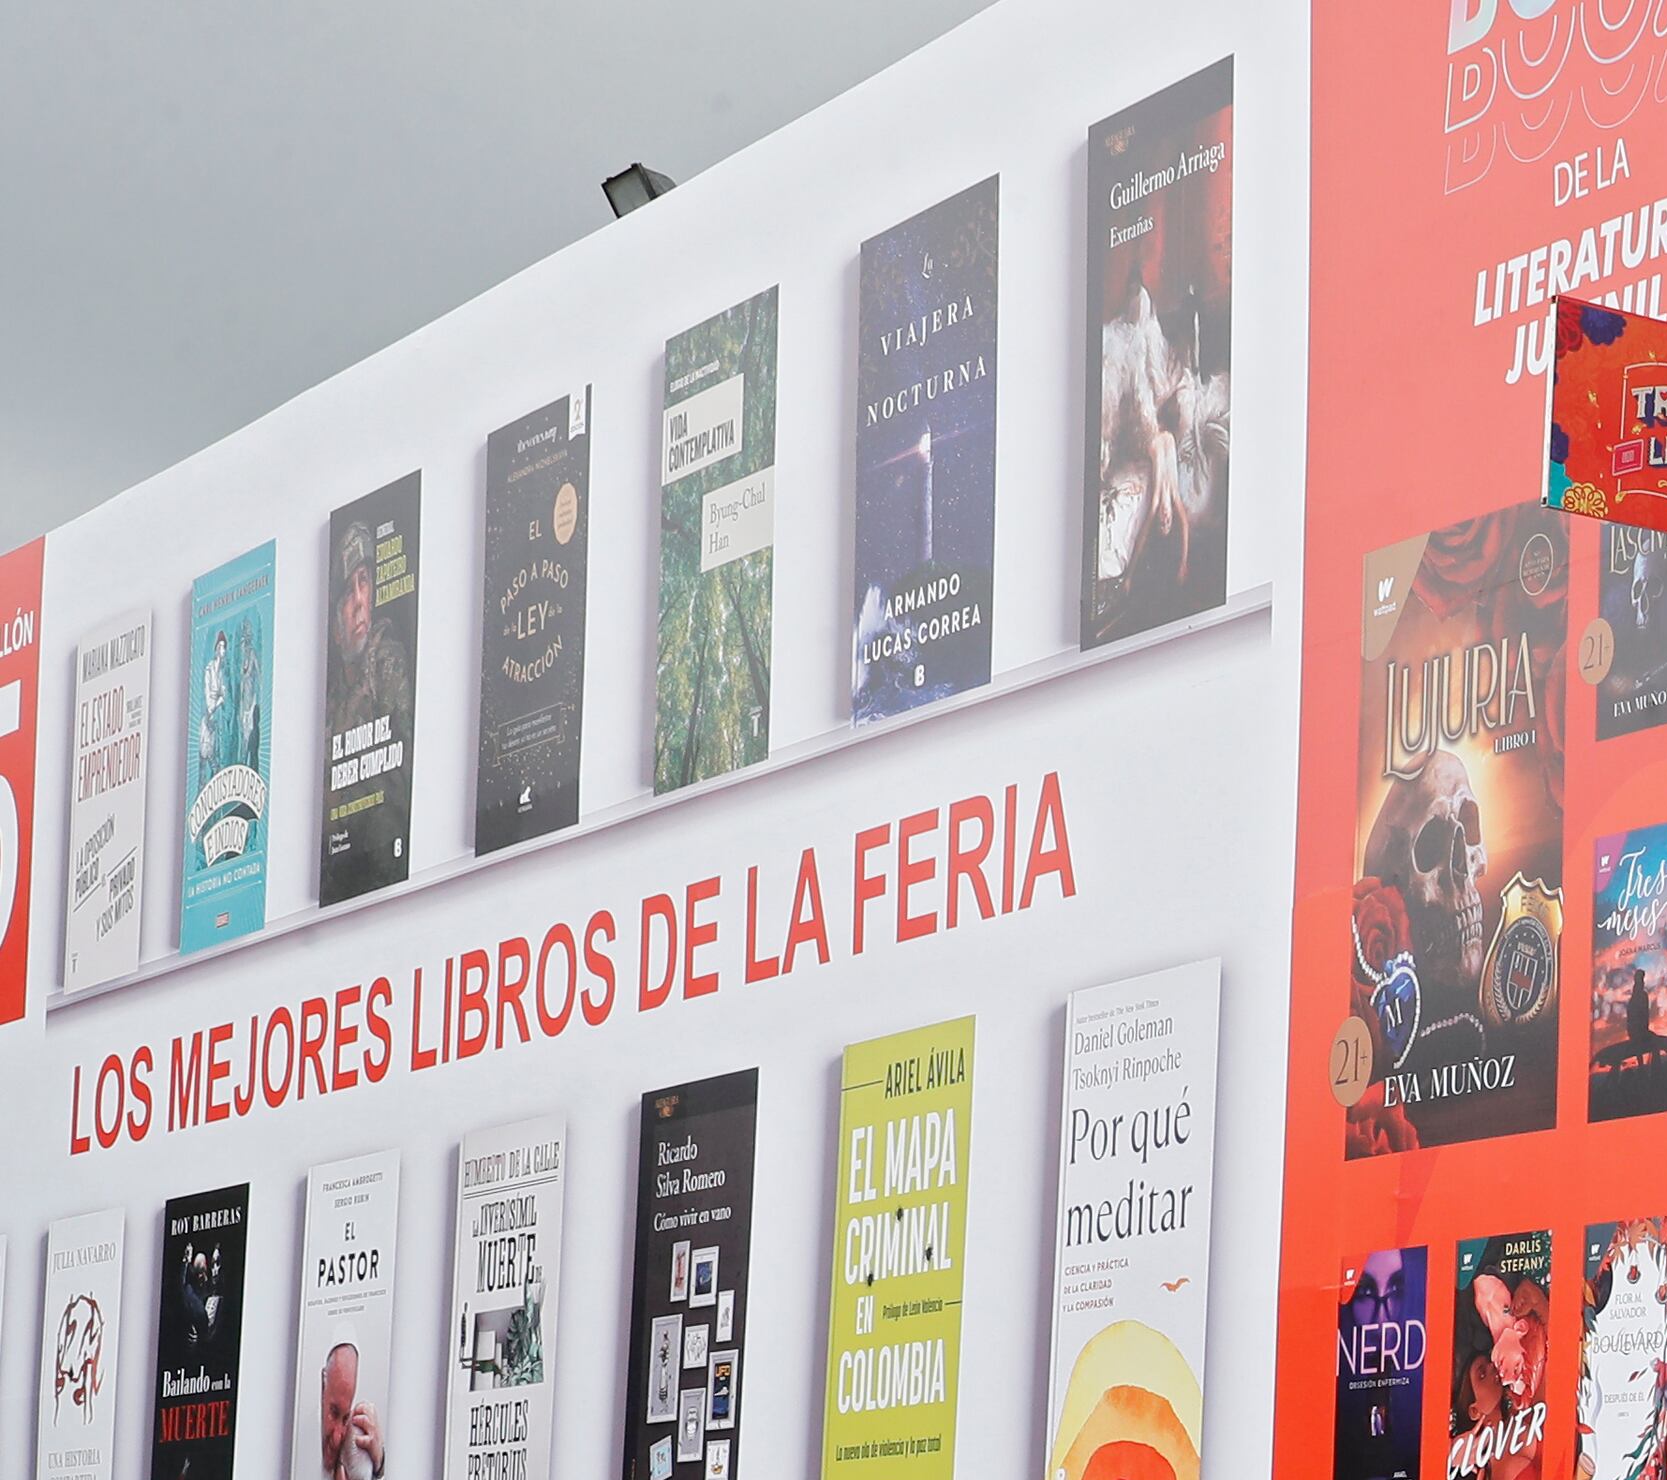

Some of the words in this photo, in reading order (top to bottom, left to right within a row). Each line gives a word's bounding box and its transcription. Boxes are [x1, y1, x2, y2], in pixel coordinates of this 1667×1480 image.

[1110, 166, 1174, 210] Guillermo
[1177, 141, 1225, 179] Arriaga
[1553, 153, 1588, 207] DE
[1596, 138, 1630, 190] LA
[1110, 216, 1154, 248] Extrañas
[880, 296, 973, 356] VIAJERA
[866, 355, 987, 427] NOCTURNA
[669, 419, 734, 472] CONTEMPLATIVA
[670, 412, 687, 442] VIDA
[710, 483, 765, 528] Byung-Chul
[709, 534, 728, 553] Han
[516, 600, 549, 640] LEY
[883, 573, 961, 621] ARMANDO
[863, 626, 912, 665] LUCAS
[917, 604, 981, 645] CORREA
[502, 635, 564, 682] ATRACCIÓN
[1382, 632, 1536, 781] LUJURIA
[190, 771, 265, 837] CONQUISTADORES
[70, 1044, 153, 1156] LOS
[166, 976, 391, 1132] MEJORES
[411, 909, 615, 1071] LIBROS
[639, 876, 720, 1012] DE
[744, 847, 829, 983] LA
[853, 773, 1076, 955] FERIA
[1074, 1023, 1113, 1056] Daniel
[1117, 1014, 1173, 1047] Goleman
[883, 1059, 922, 1099] ARIEL
[927, 1047, 965, 1089] ÁVILA
[1072, 1058, 1118, 1092] Tsoknyi
[1122, 1050, 1181, 1085] Rinpoche
[1335, 1038, 1369, 1084] 21+
[1383, 1068, 1423, 1110] EVA
[1430, 1054, 1516, 1097] MUÑOZ
[1069, 1107, 1124, 1166] Por
[1130, 1085, 1192, 1168] qué
[657, 1136, 698, 1166] Ricardo
[848, 1126, 876, 1204] EL
[883, 1108, 956, 1198] MAPA
[656, 1172, 680, 1198] Silva
[683, 1169, 726, 1192] Romero
[171, 1213, 189, 1235] ROY
[192, 1207, 241, 1233] BARRERAS
[344, 1221, 355, 1242] EL
[1065, 1180, 1193, 1248] meditar
[845, 1201, 951, 1285] CRIMINAL
[1500, 1255, 1545, 1273] STEFANY
[1505, 1239, 1541, 1256] DARLIS
[318, 1249, 380, 1288] PASTOR
[855, 1296, 873, 1336] EN
[1335, 1319, 1426, 1375] NERD
[162, 1366, 209, 1398] Bailando
[837, 1338, 945, 1415] COLOMBIA
[159, 1401, 229, 1443] MUERTE
[470, 1398, 528, 1447] HÉRCULES
